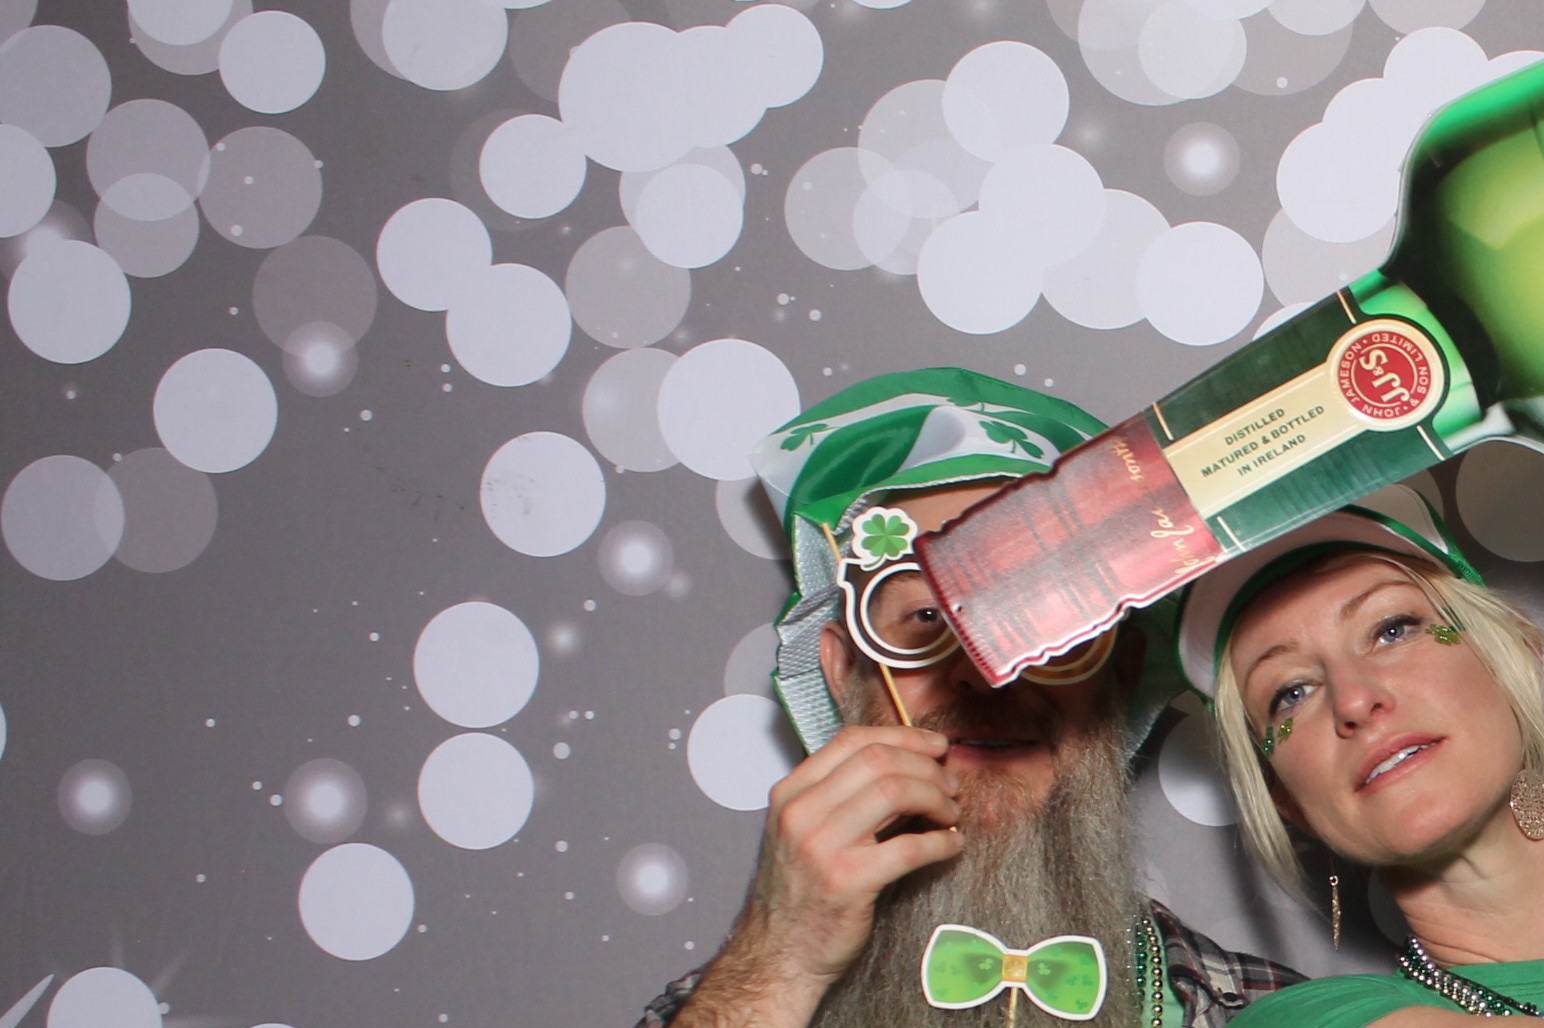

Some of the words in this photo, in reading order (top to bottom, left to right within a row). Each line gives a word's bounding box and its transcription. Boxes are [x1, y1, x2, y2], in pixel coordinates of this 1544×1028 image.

[1371, 332, 1424, 362] LIMITED
[1339, 343, 1362, 403] JAMESON
[1359, 349, 1410, 402] JJ&S
[1416, 366, 1429, 395] SON
[1362, 404, 1401, 418] JOHN
[1409, 398, 1420, 407] &
[1200, 441, 1259, 478] MATURED
[1261, 435, 1271, 445] &
[1270, 405, 1325, 440] BOTTLED
[1224, 407, 1285, 446] DISTILLED
[1237, 463, 1252, 477] IN
[1252, 433, 1307, 468] IRELAND
